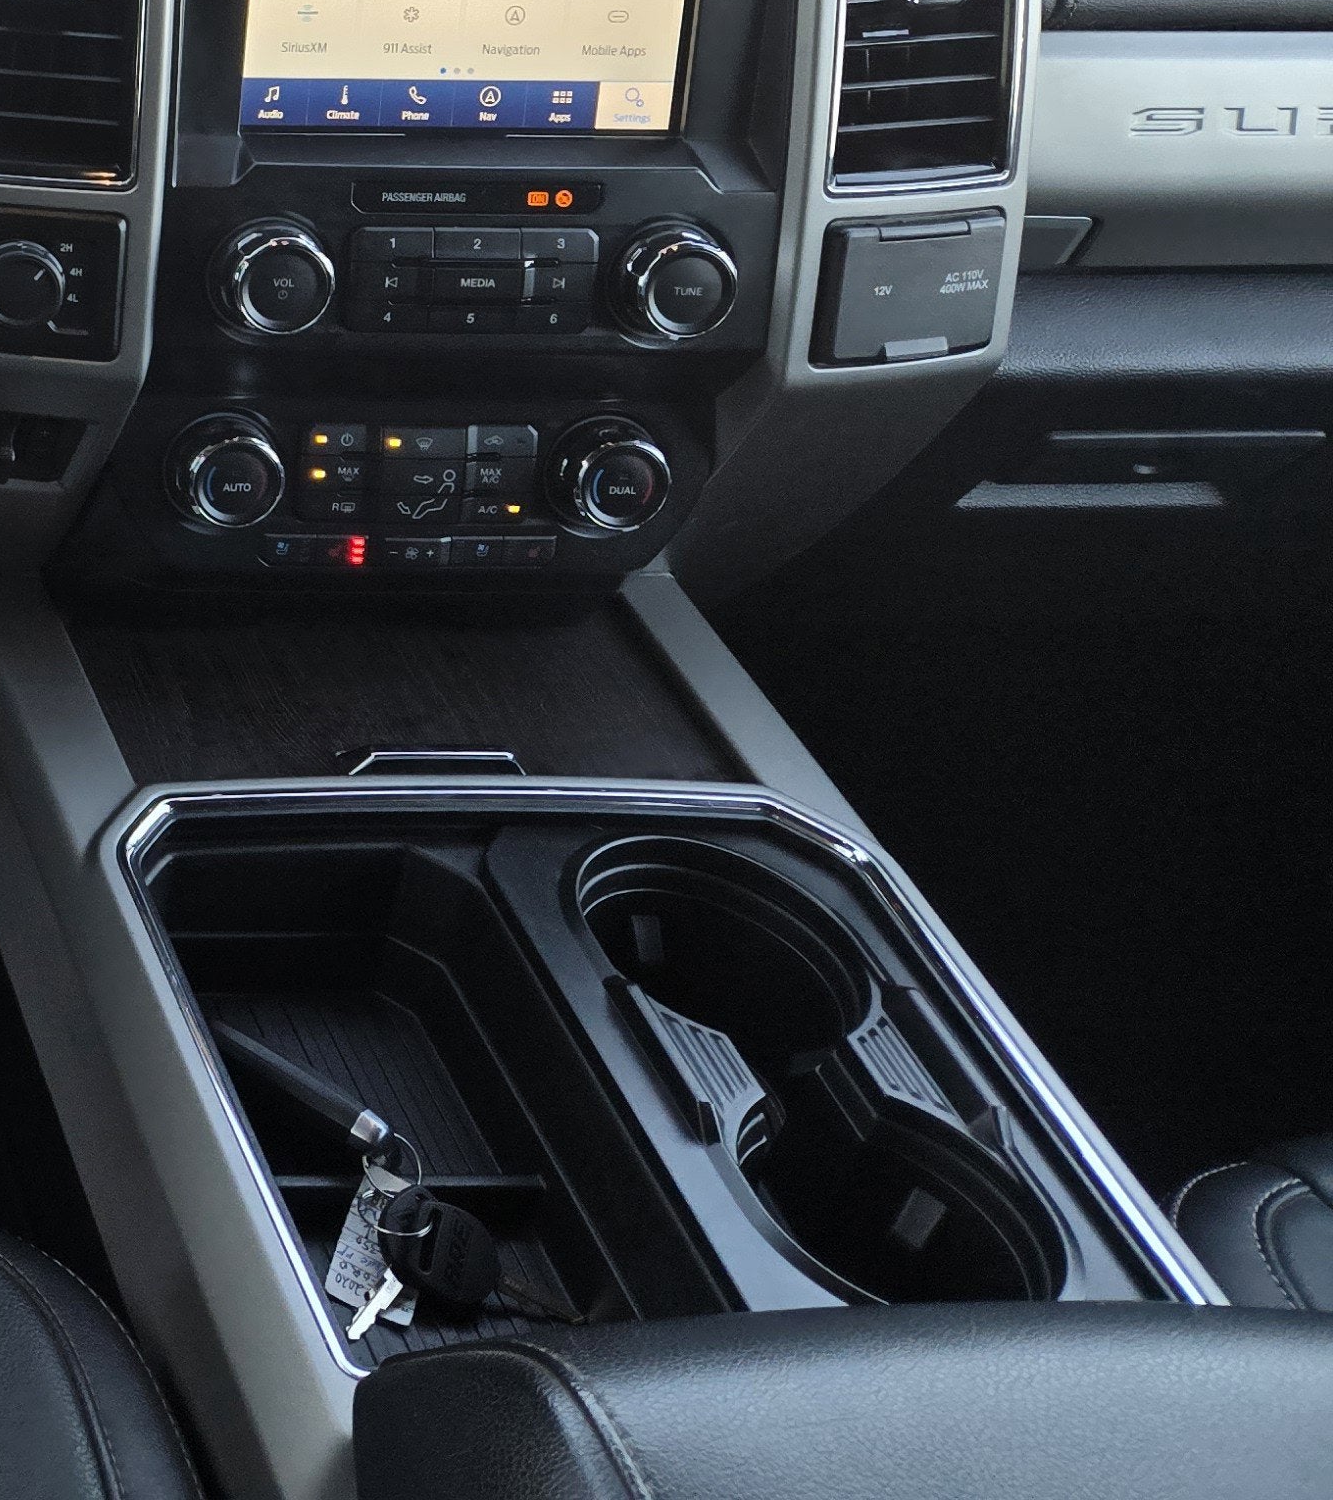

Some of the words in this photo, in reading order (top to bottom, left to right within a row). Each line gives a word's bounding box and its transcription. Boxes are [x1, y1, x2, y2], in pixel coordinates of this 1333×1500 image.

[280, 41, 328, 54] SiriusXM
[382, 42, 399, 54] 911
[400, 42, 432, 55] Assist
[481, 43, 541, 57] Navigation
[581, 44, 615, 56] Mobile
[619, 44, 647, 59] Apps
[257, 109, 284, 120] Audio
[326, 109, 360, 120] Climate
[401, 110, 430, 121] Phone
[479, 111, 498, 122] Nav
[548, 112, 572, 124] Apps
[613, 113, 651, 125] Settings
[381, 192, 433, 203] PASSENGER
[433, 192, 467, 203] AIRBAG
[59, 242, 73, 253] 2H
[389, 237, 396, 249] 1
[473, 238, 482, 250] 2
[556, 237, 566, 249] 3
[69, 267, 83, 277] 4H
[944, 271, 960, 282] AC
[962, 269, 985, 281] 110V
[273, 277, 295, 288] VOL
[460, 277, 496, 288] MEDIA
[939, 283, 967, 295] 400W
[967, 279, 989, 291] MAX
[674, 286, 704, 296] TUNE
[873, 284, 893, 296] 12V
[66, 293, 79, 303] 4L
[383, 311, 391, 323] 4
[466, 312, 475, 324] 5
[549, 313, 558, 324] 6
[336, 466, 361, 476] MAX
[479, 467, 503, 477] MAX
[480, 475, 501, 486] A/C
[222, 482, 252, 492] AUTO
[608, 485, 637, 495] DUAL
[331, 502, 340, 512] R
[477, 505, 498, 515] A/C
